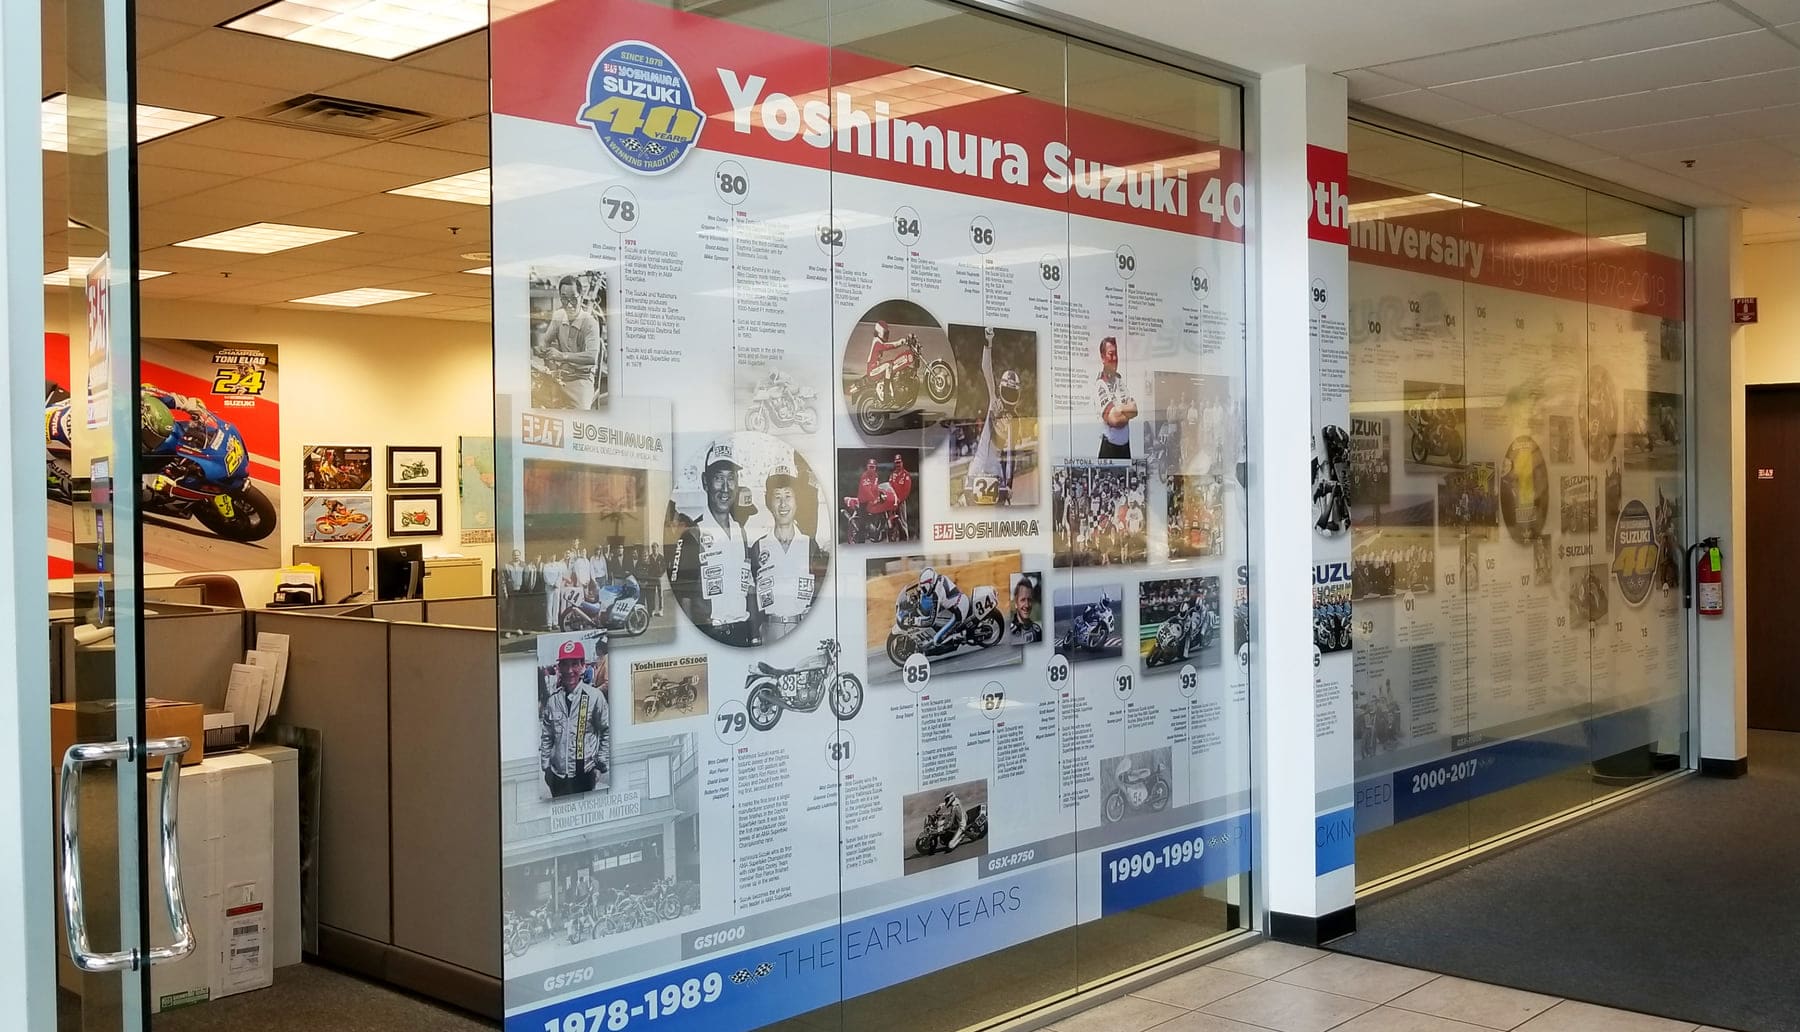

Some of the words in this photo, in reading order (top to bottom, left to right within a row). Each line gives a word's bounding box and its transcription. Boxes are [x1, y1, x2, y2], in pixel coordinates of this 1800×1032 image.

[621, 51, 646, 62] SINCE
[618, 65, 681, 88] YOSHIMURA
[603, 76, 681, 105] SUZUKI
[583, 96, 701, 143] 40
[654, 132, 687, 142] YEARS
[716, 67, 1029, 187] Yoshimura
[1043, 141, 1188, 217] Suzuki
[609, 143, 642, 167] WINNING
[644, 147, 680, 168] TRADITION
[716, 171, 747, 195] '80
[602, 197, 635, 221] '78
[894, 216, 920, 237] '84
[971, 225, 993, 246] '86
[1308, 181, 1348, 229] th
[1490, 236, 1587, 292] Highlights
[1040, 263, 1060, 282] '88
[1116, 253, 1135, 271] '90
[214, 355, 238, 364] TONI
[239, 357, 267, 365] ELIAS
[214, 370, 264, 394] 24
[572, 421, 664, 453] YOSHIMURA
[975, 479, 999, 498] 34
[954, 519, 1040, 540] YOSHIMURA
[1620, 530, 1651, 544] SUZUKI
[671, 539, 684, 582] SUZUKI
[634, 659, 678, 671] Yoshimura
[904, 664, 928, 684] '85
[1047, 665, 1068, 683] '89
[782, 675, 796, 692] 83
[717, 712, 747, 734] '79
[828, 741, 850, 761] '81
[1412, 759, 1478, 793] 2000-2017
[552, 801, 577, 817] HONDA
[578, 793, 623, 812] YOSHIMURA
[552, 807, 605, 830] COMPETITION
[609, 802, 640, 819] MOTORS
[988, 850, 1035, 871] GSX-R750
[1109, 837, 1204, 883] 1990-1999
[694, 925, 746, 951] GS1000
[778, 938, 836, 980] THE
[846, 910, 934, 961] EARLY
[941, 885, 1021, 931] YEARS
[543, 966, 595, 992] GS750
